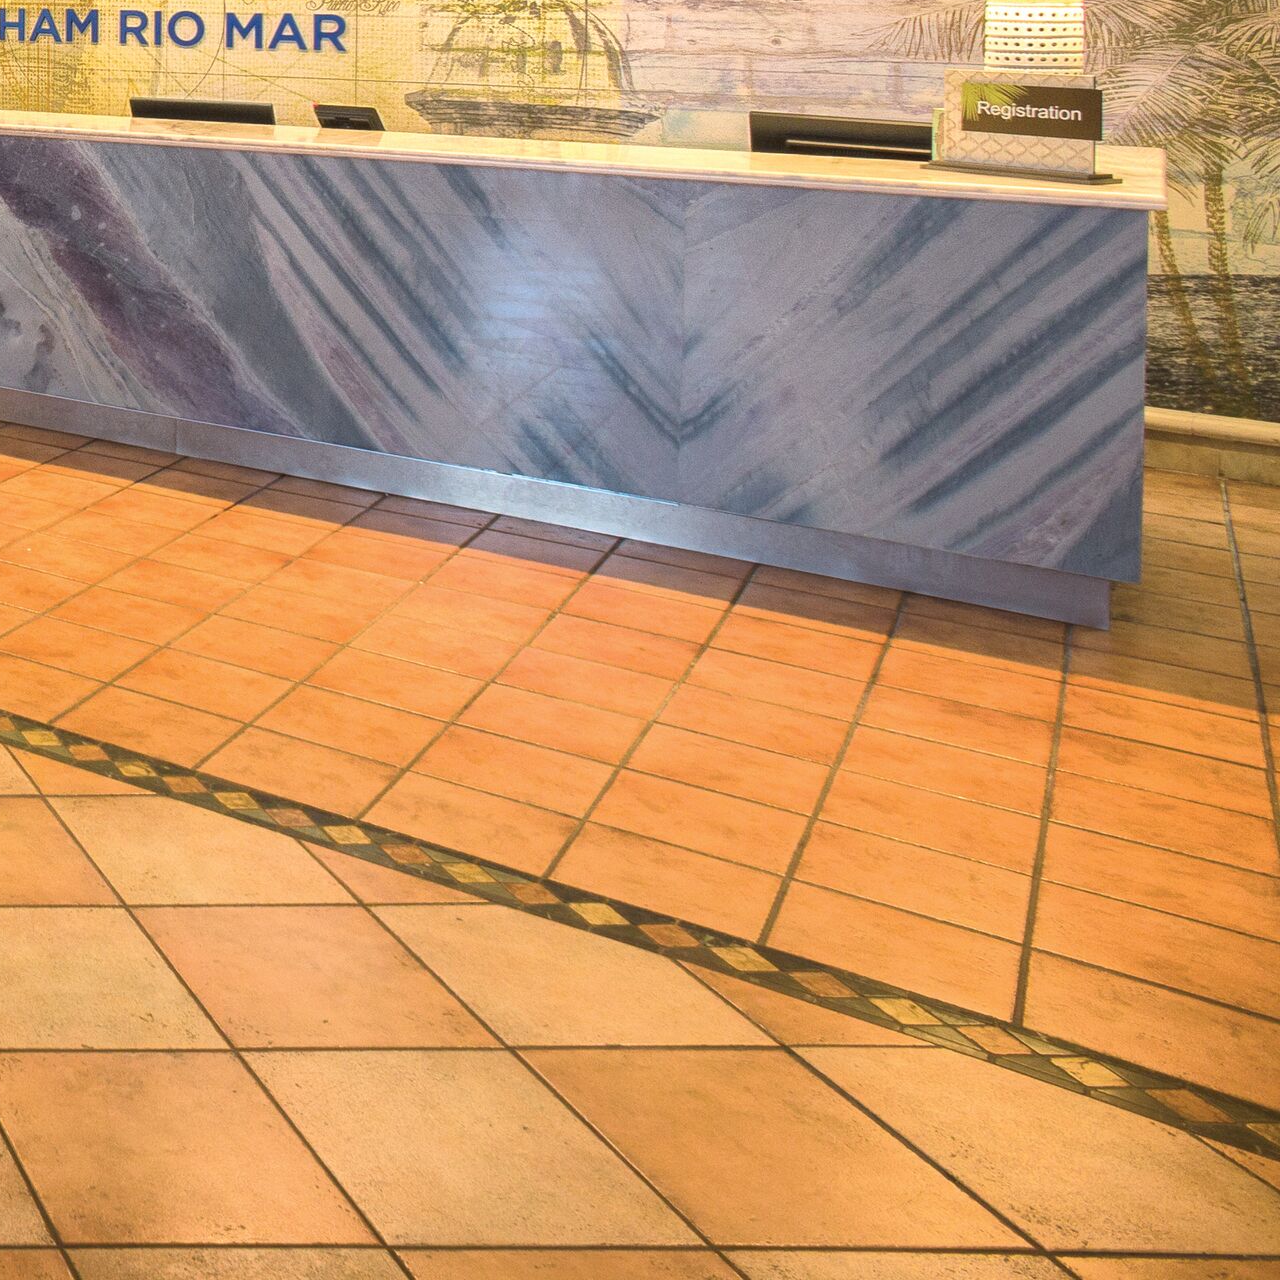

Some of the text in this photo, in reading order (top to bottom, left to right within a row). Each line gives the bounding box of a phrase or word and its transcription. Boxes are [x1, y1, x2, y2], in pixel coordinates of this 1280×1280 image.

[119, 10, 206, 48] RIO
[225, 12, 348, 53] MAR
[977, 100, 1082, 121] Registration
